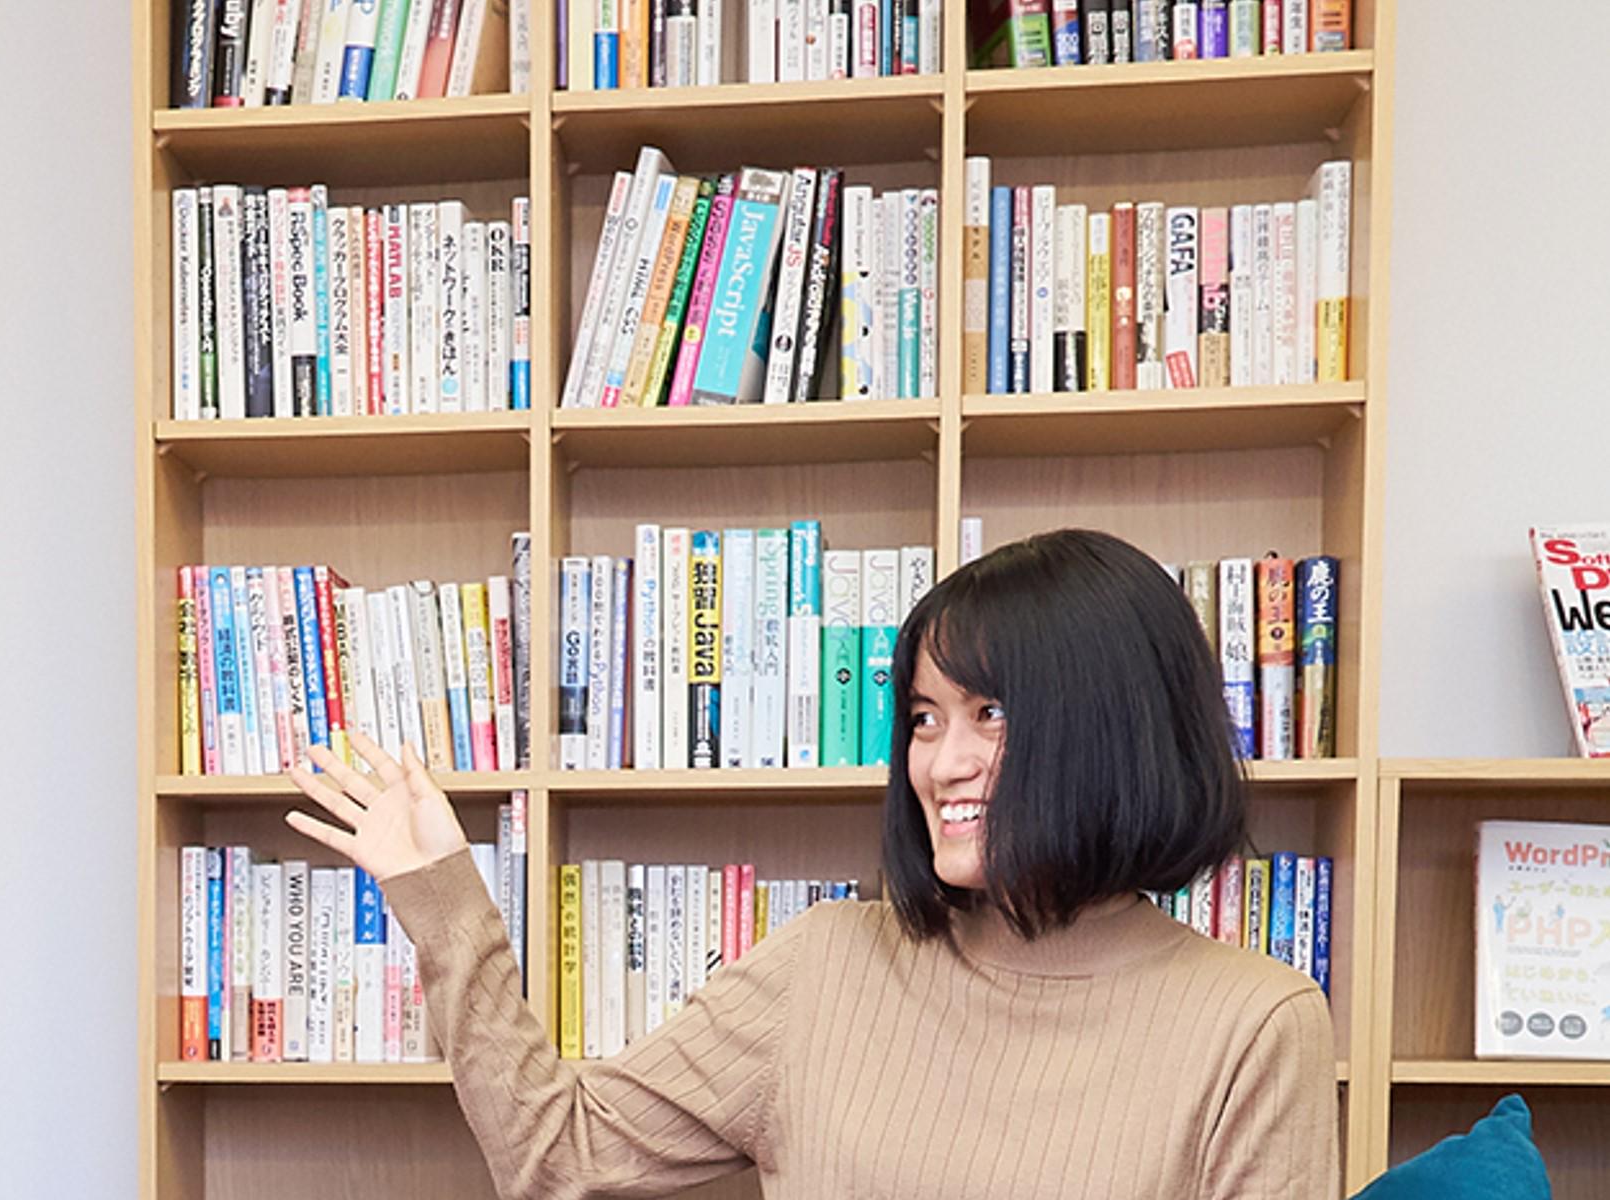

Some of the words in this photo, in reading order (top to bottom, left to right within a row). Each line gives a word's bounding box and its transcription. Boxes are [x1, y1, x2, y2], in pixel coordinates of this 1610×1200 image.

[220, 0, 246, 40] uby
[290, 211, 307, 271] RSpec
[388, 226, 402, 298] MATLAB
[1170, 212, 1196, 275] GAFA
[711, 205, 766, 337] JavaScript
[292, 275, 307, 322] Book
[1543, 540, 1610, 566] Soft
[1551, 588, 1610, 631] We
[694, 612, 719, 677] Java
[1505, 840, 1610, 868] WordPr
[289, 873, 304, 917] WHO
[289, 920, 304, 957] YOU
[289, 960, 304, 995] ARE
